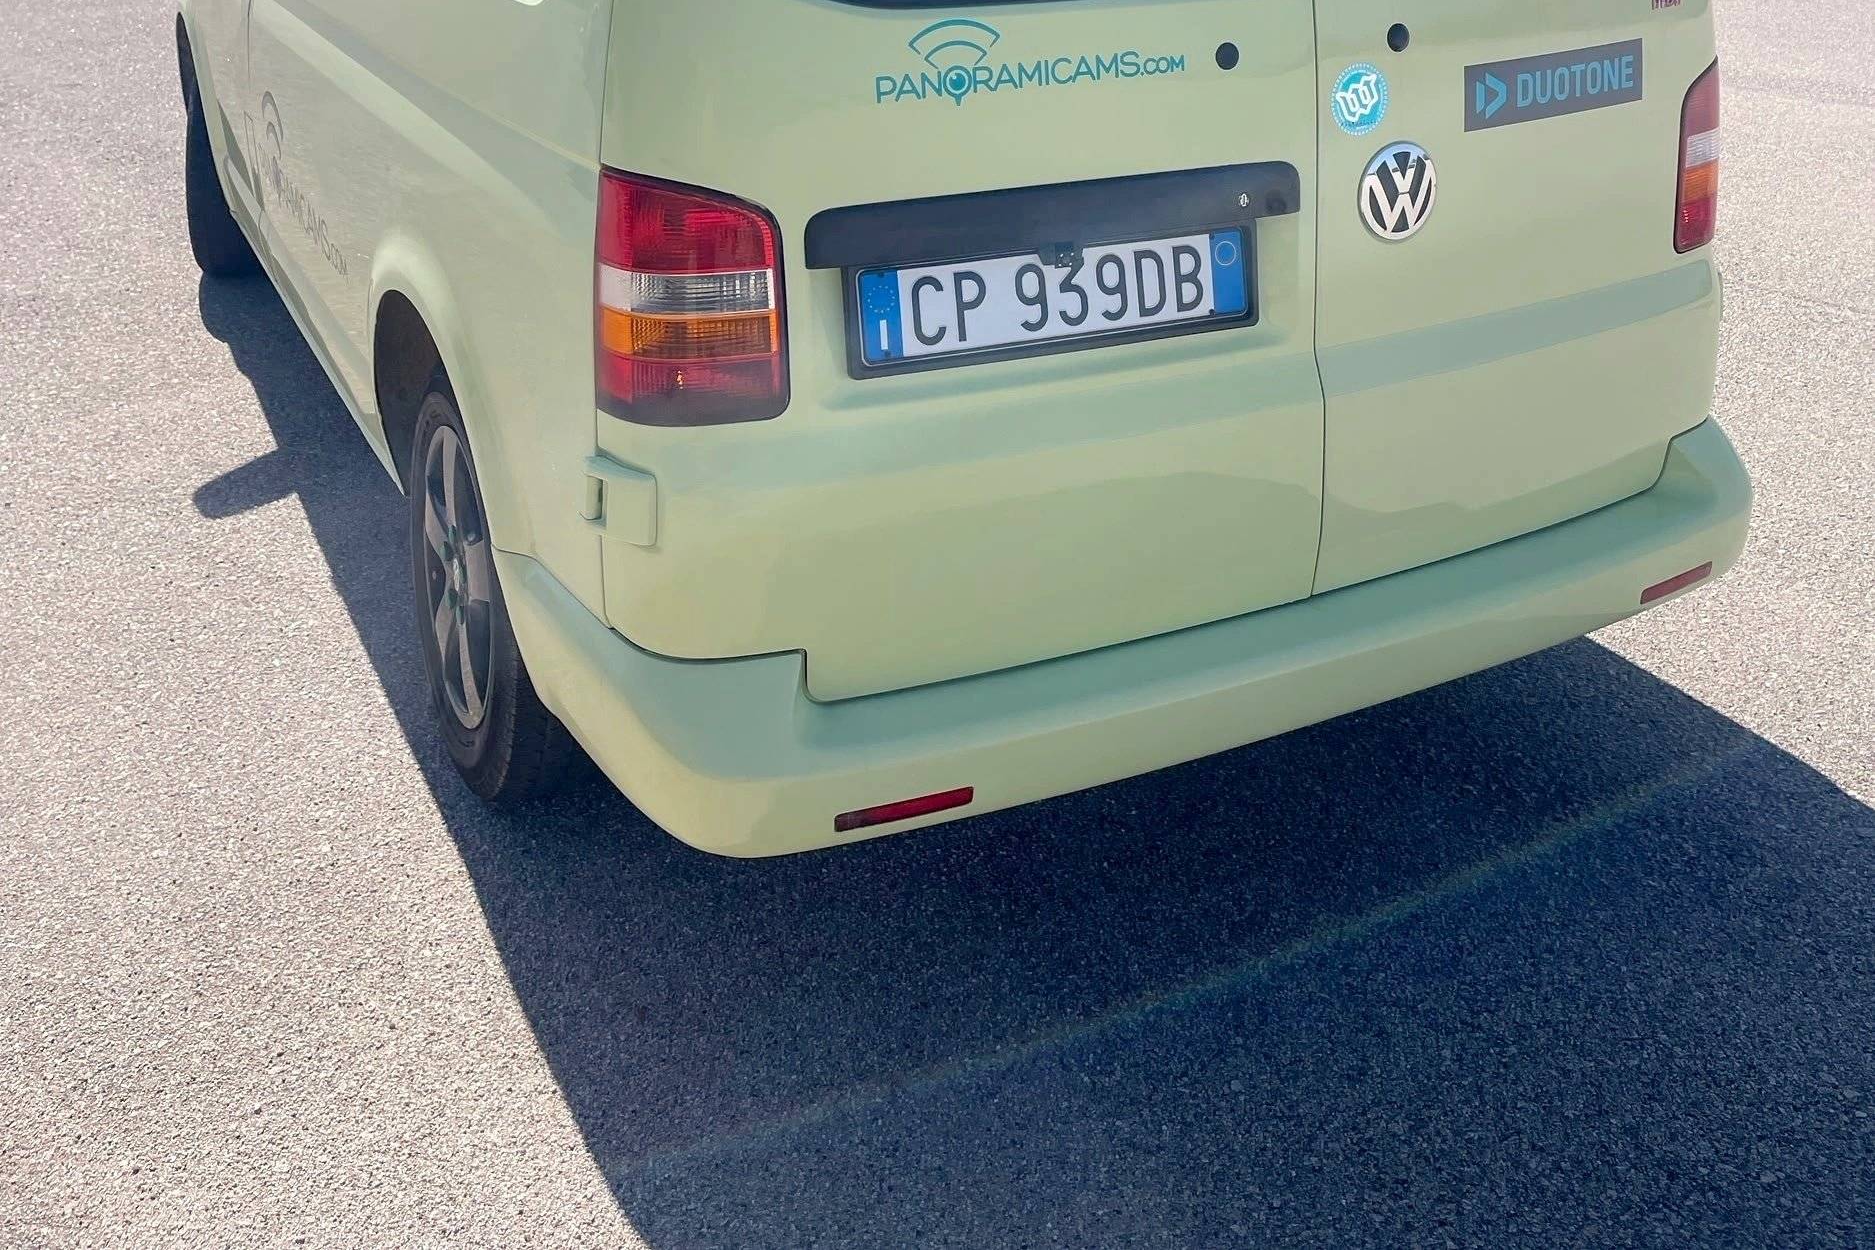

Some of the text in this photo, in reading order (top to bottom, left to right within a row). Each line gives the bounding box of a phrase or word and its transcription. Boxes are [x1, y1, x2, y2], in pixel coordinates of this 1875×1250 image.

[1516, 55, 1634, 108] DUOTONE
[911, 271, 987, 347] CP
[1014, 244, 1206, 332] 939DB
